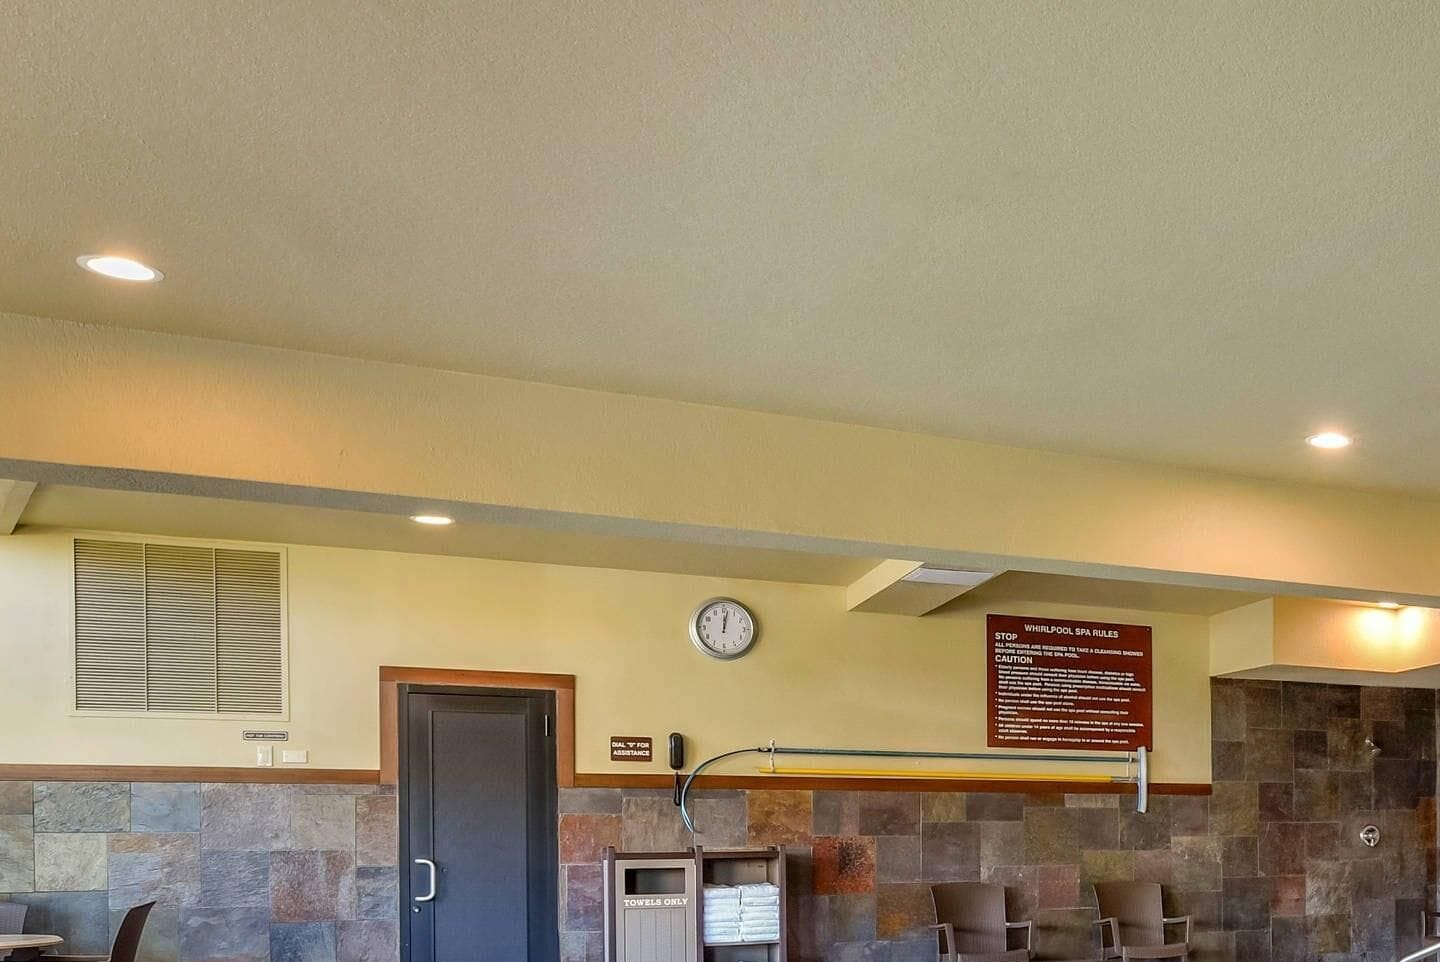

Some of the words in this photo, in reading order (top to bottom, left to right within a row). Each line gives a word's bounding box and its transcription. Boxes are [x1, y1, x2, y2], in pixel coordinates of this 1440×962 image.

[1024, 624, 1074, 636] WHIRLPOOL
[1075, 628, 1091, 636] SPA
[1092, 629, 1118, 638] RULES
[995, 632, 1018, 640] STOP
[994, 655, 1032, 664] CAUTION
